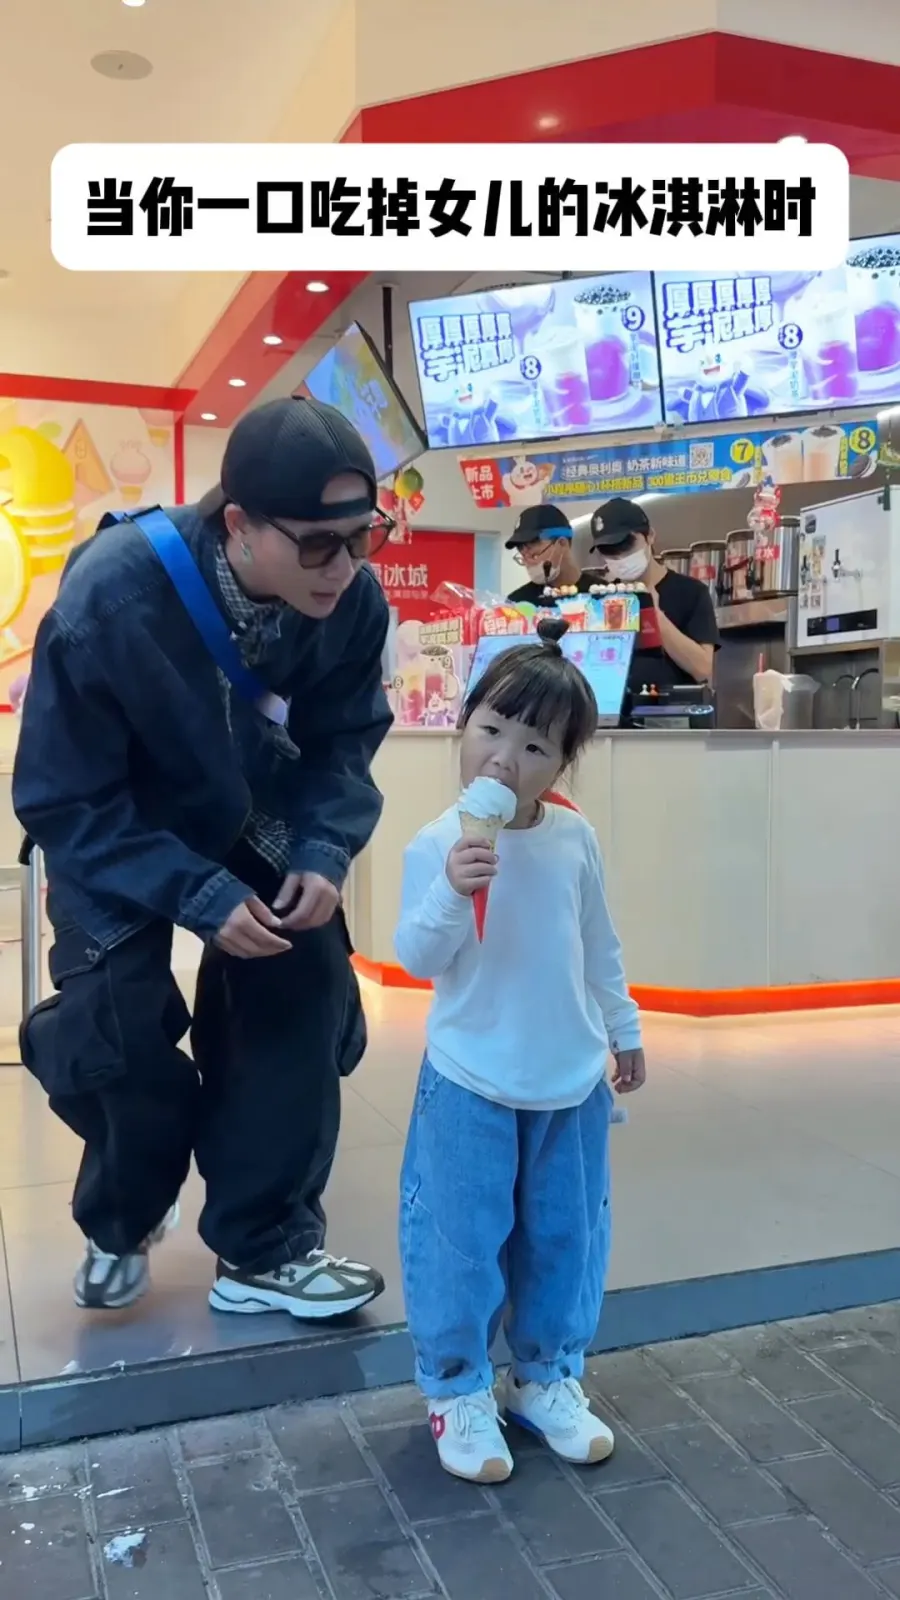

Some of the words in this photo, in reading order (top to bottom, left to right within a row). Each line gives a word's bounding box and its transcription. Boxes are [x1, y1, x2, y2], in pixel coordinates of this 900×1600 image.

[627, 307, 642, 330] 9
[784, 324, 799, 348] 8
[524, 356, 538, 379] 8
[857, 430, 870, 450] 8
[738, 442, 749, 461] 7
[465, 465, 493, 483] 新品
[471, 483, 494, 500] 上市
